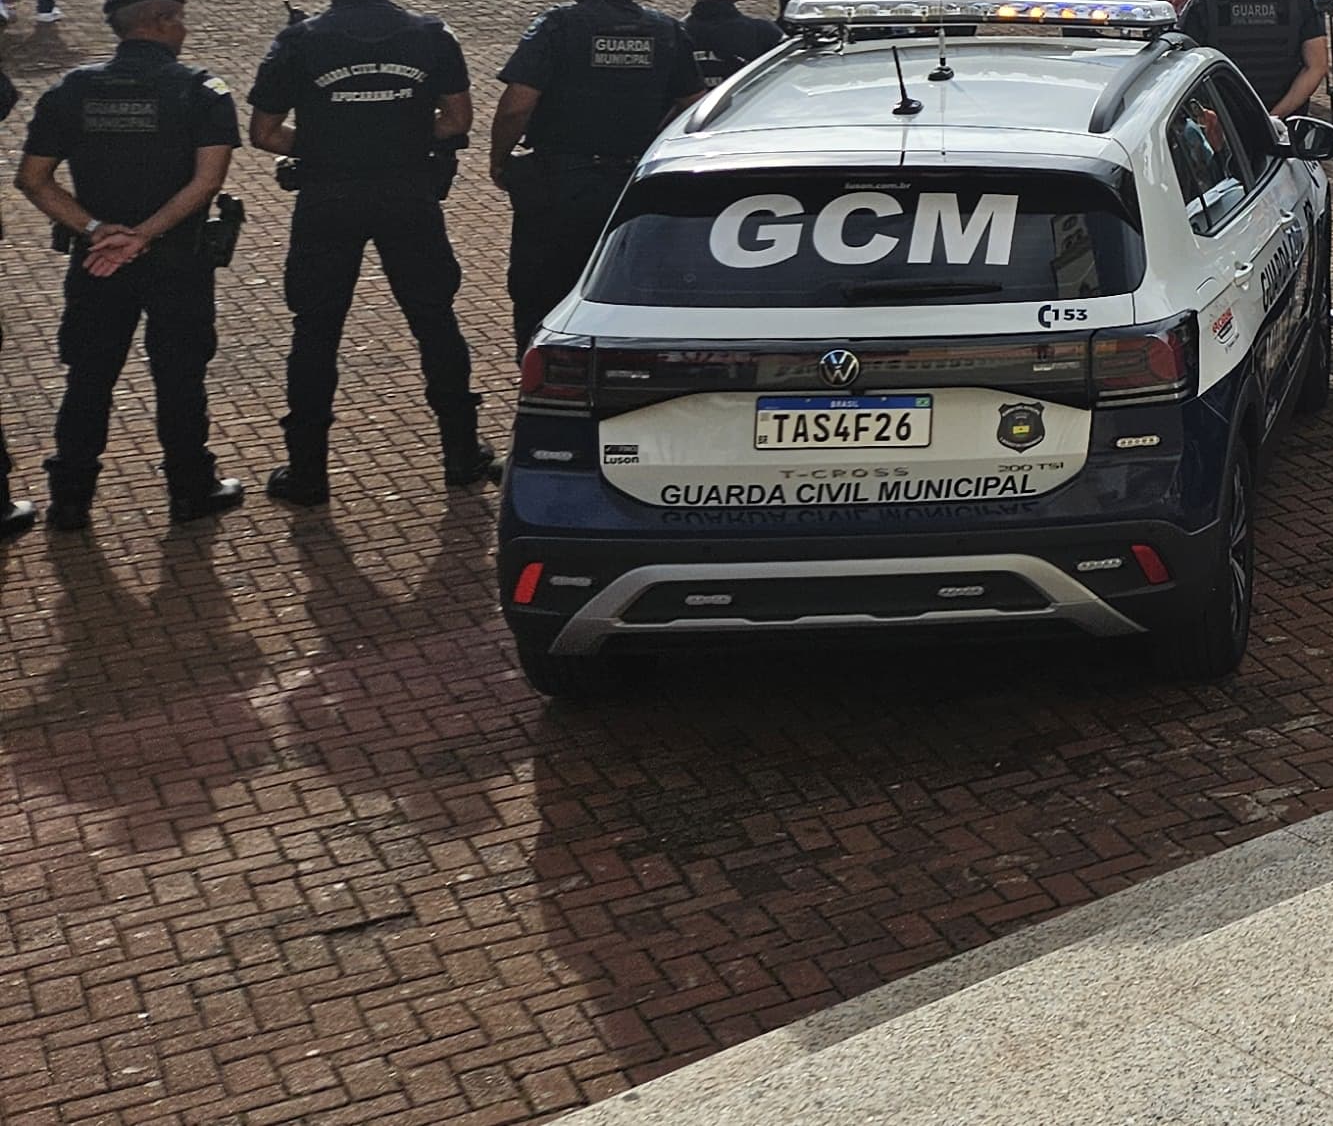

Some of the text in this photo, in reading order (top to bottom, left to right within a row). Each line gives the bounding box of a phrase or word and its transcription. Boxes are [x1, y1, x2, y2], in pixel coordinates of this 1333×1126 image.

[1231, 4, 1277, 17] GUARDA
[594, 38, 652, 52] GUARDA
[594, 53, 652, 66] MUNICIPAL
[708, 191, 1019, 269] GCM
[1051, 308, 1088, 322] 153
[830, 400, 860, 408] BRASIL
[772, 413, 913, 443] TAS4F26
[604, 456, 640, 464] Luson
[779, 467, 910, 480] T-CROSS
[998, 462, 1064, 473] 200 TSI
[660, 474, 1038, 506] GUARDA CIVIL MUNICIPAL
